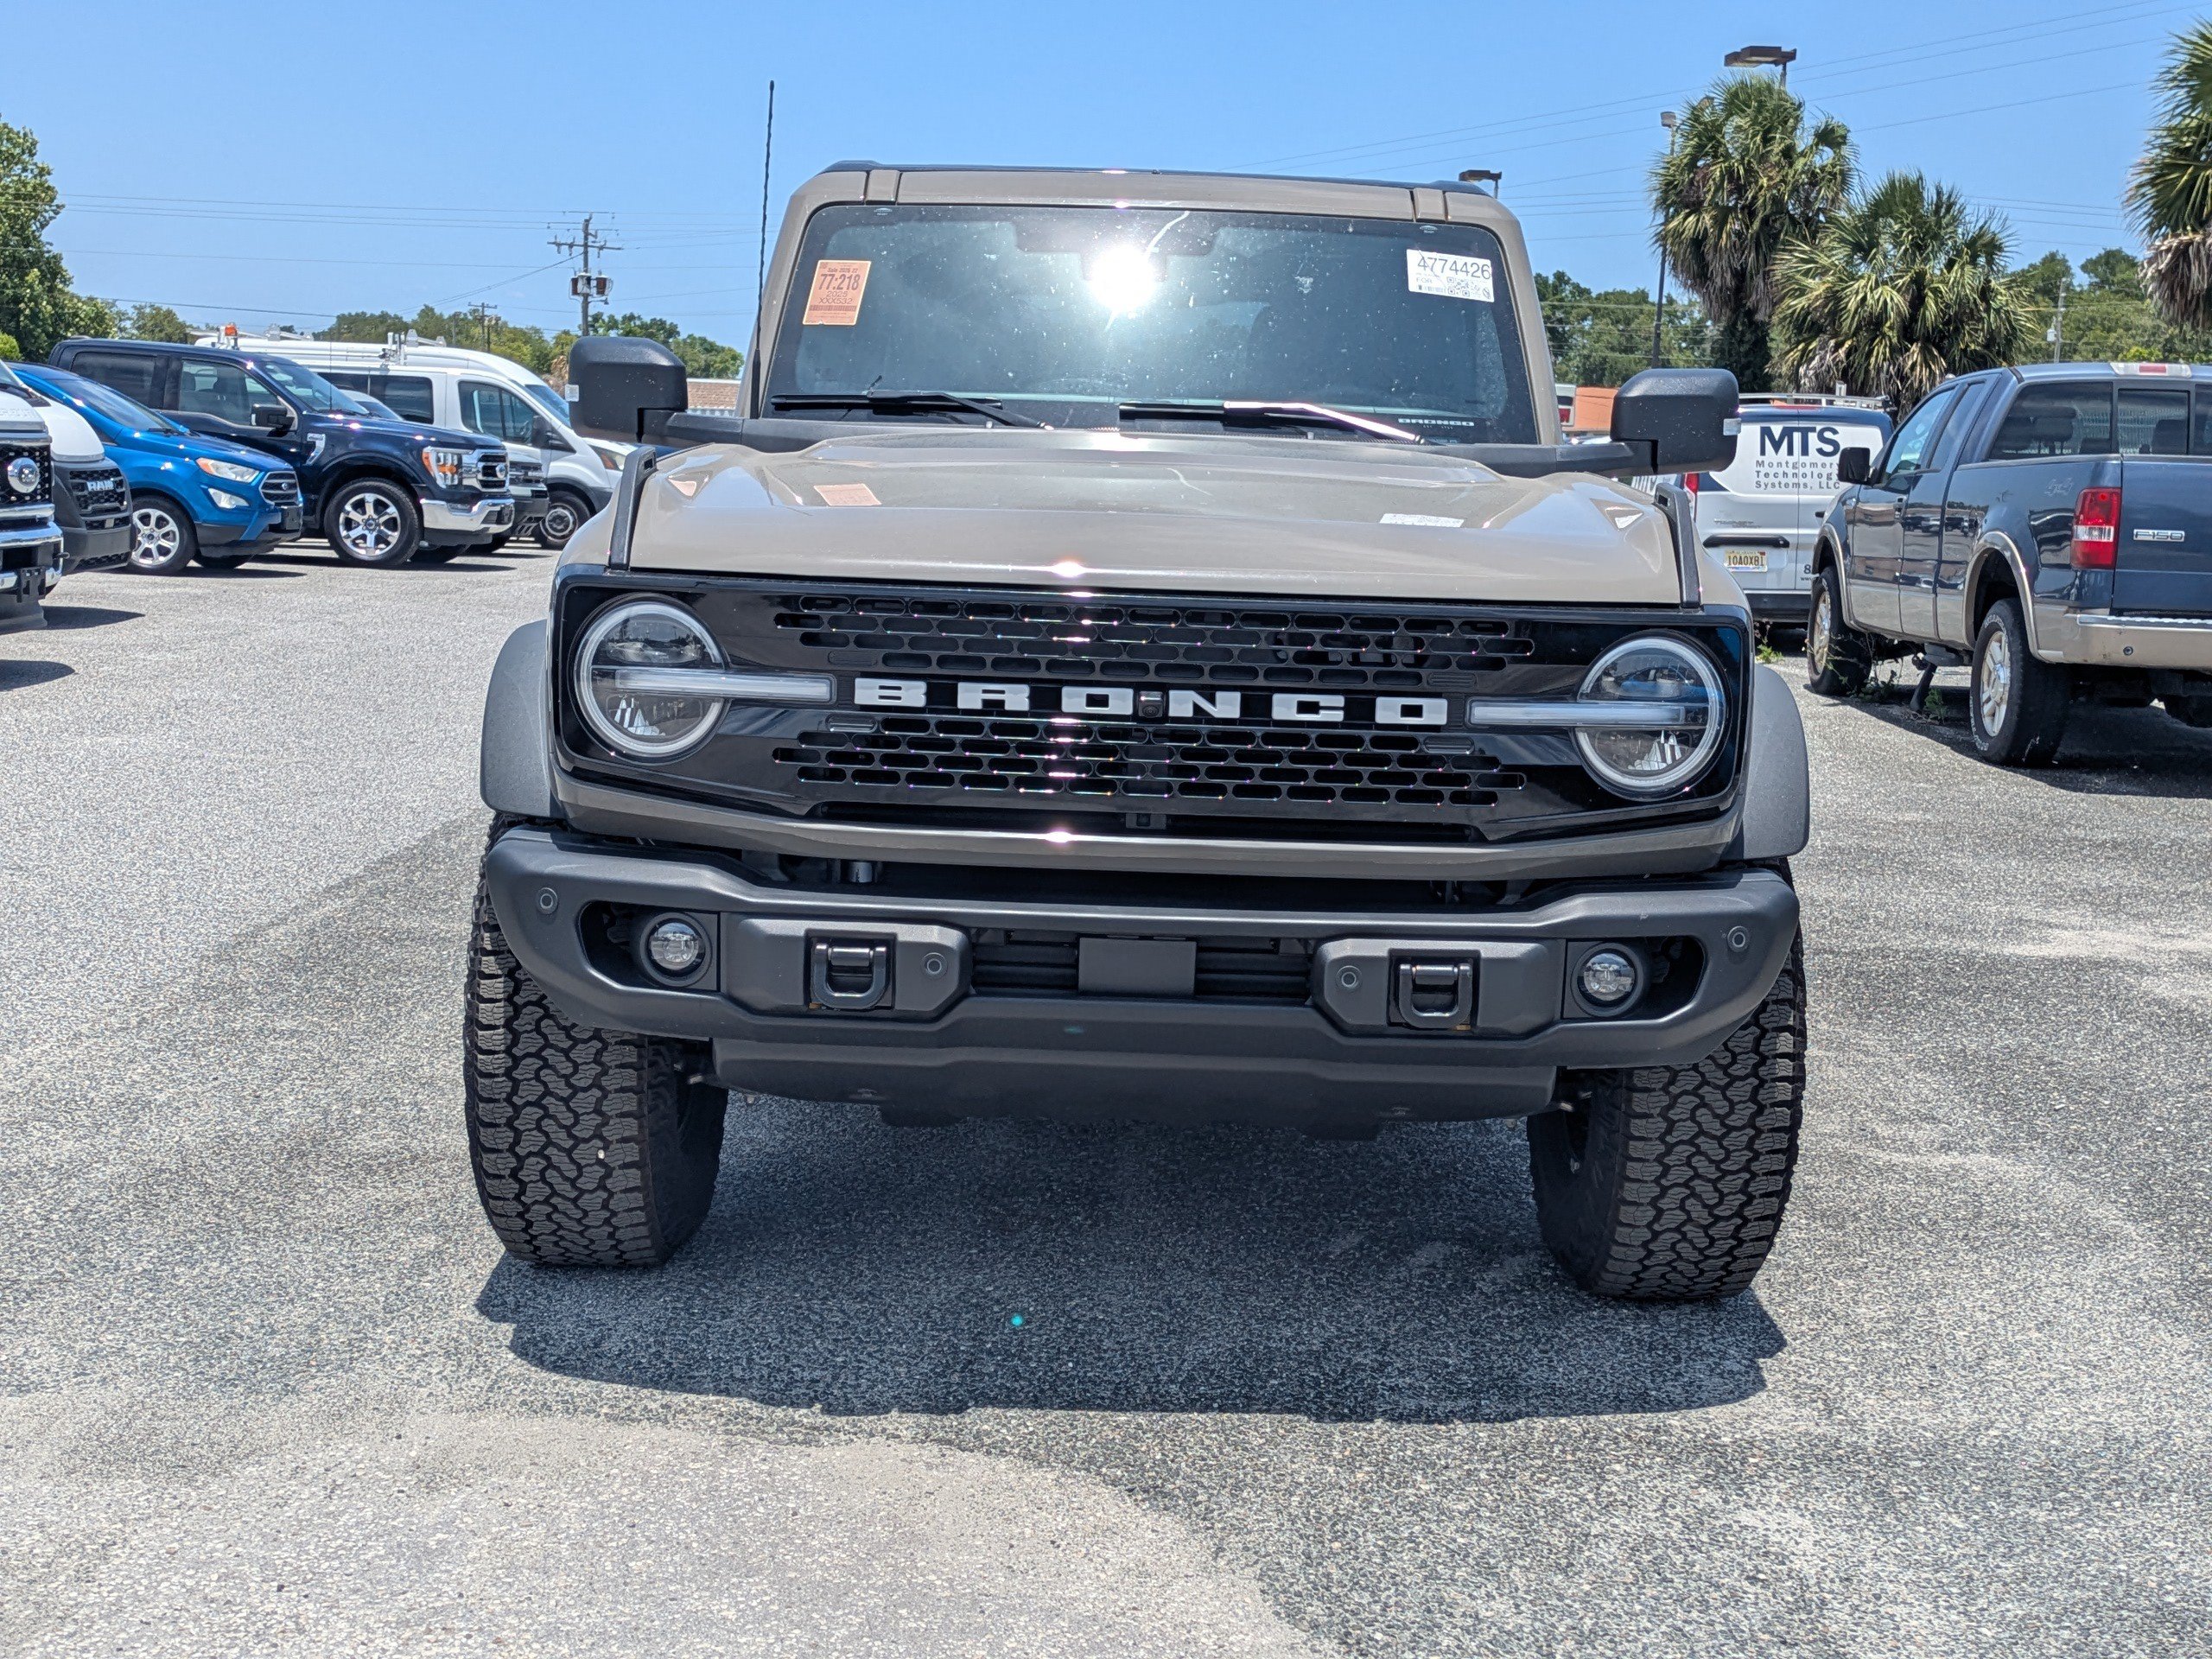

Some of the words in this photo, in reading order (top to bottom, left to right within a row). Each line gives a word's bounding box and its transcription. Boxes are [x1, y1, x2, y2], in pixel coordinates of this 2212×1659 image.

[1417, 256, 1491, 280] 4774426
[1759, 426, 1840, 457] MTS
[86, 480, 115, 492] RAM
[1755, 480, 1813, 491] Systems,
[1818, 480, 1840, 490] LLC
[854, 677, 1449, 726] BRONCO
